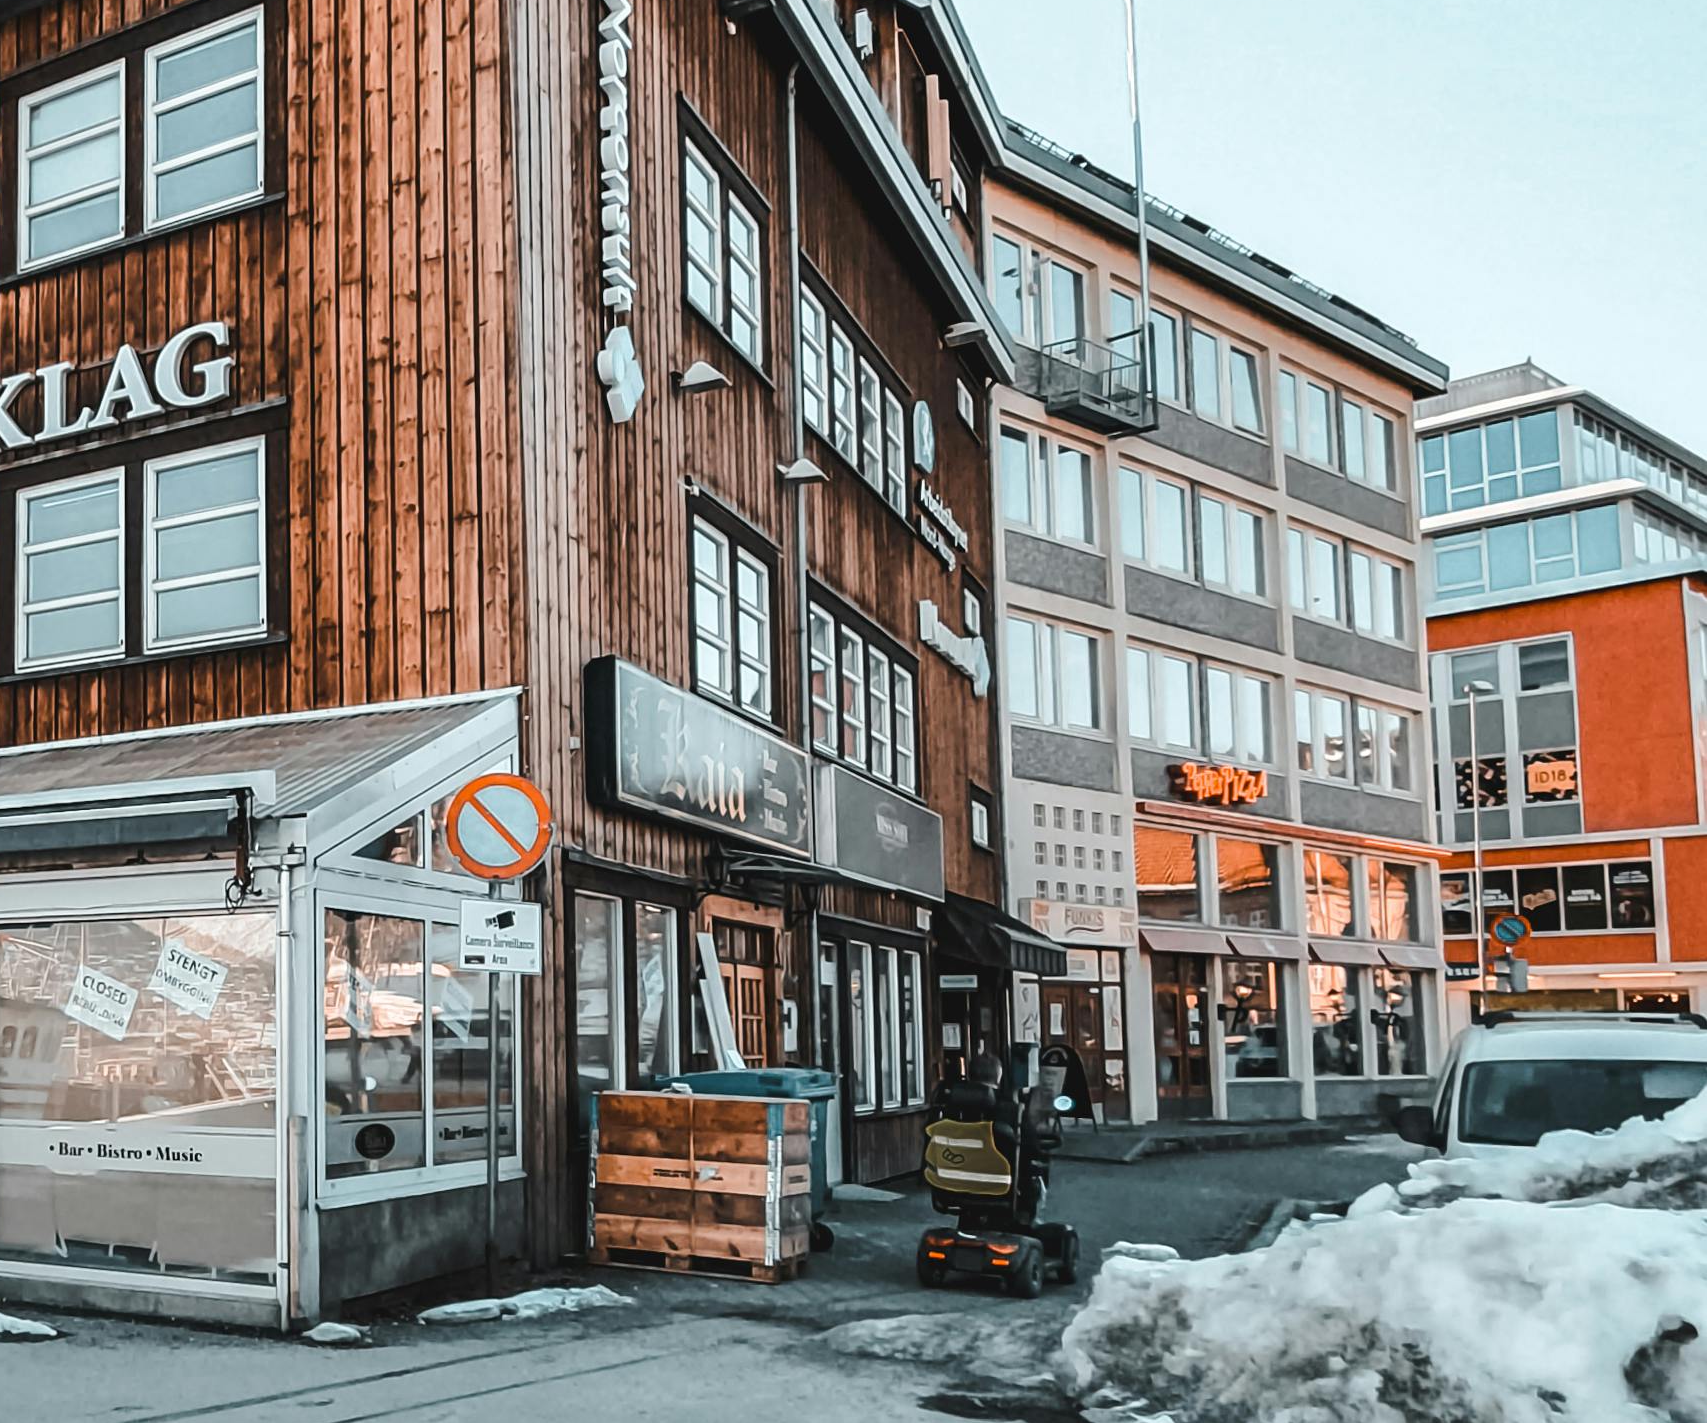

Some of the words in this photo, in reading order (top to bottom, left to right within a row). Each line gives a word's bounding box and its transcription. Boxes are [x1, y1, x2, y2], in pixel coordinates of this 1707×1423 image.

[657, 698, 746, 823] Kaia
[465, 935, 492, 947] Camera
[168, 948, 219, 983] STENGT
[83, 975, 128, 1005] CLOSED
[59, 1141, 84, 1156] Bar
[97, 1143, 142, 1160] Bistro
[156, 1146, 203, 1162] Music
